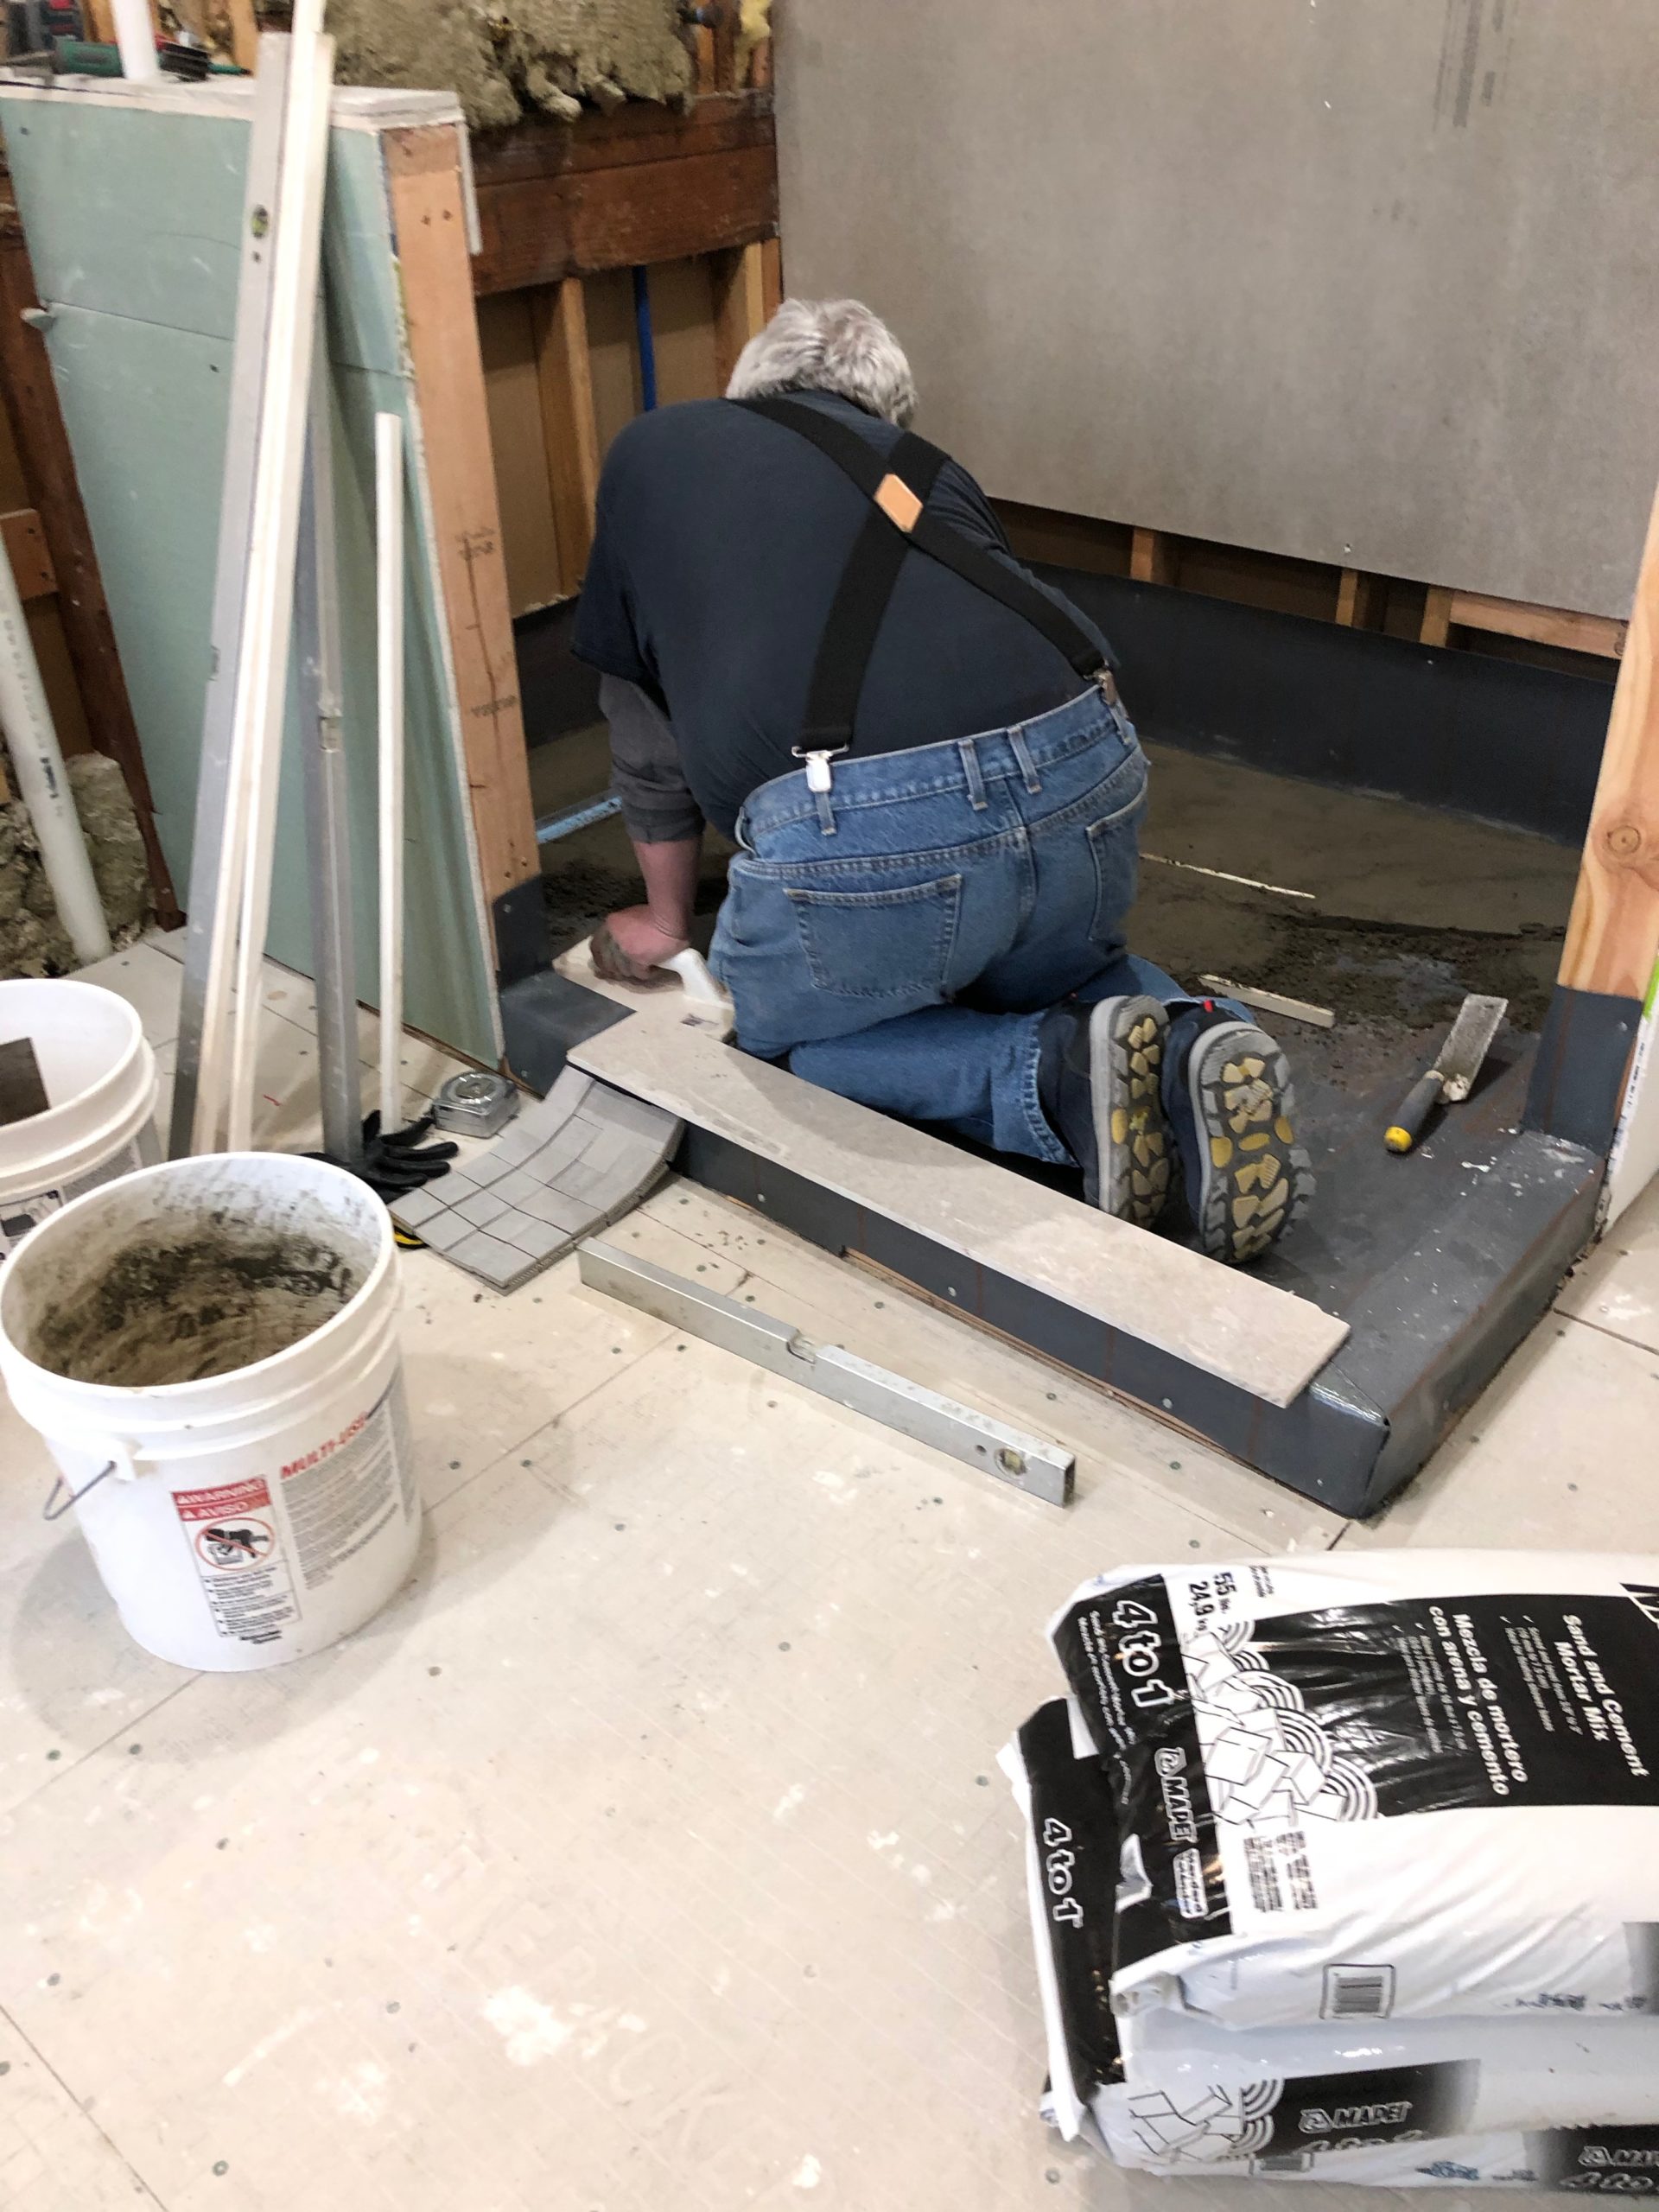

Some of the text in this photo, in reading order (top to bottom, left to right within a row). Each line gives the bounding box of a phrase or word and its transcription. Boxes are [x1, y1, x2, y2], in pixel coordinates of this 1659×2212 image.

[1213, 1572, 1237, 1596] 55
[1112, 1600, 1158, 1629] 4
[1428, 1605, 1452, 1637] con
[1118, 1630, 1161, 1677] to
[1441, 1641, 1471, 1691] arena
[1452, 1613, 1529, 1783] Mezcla de mortero
[1457, 1694, 1478, 1707] y
[1554, 1641, 1593, 1703] Mortar
[1581, 1707, 1611, 1741] Mix
[1562, 1614, 1650, 1777] Sand and Cement
[1467, 1710, 1510, 1796] cemento
[1043, 1817, 1073, 1847] 4
[1161, 1777, 1198, 1843] MAPEI
[1046, 1849, 1076, 1895] to
[1332, 2101, 1414, 2129] MAPEI
